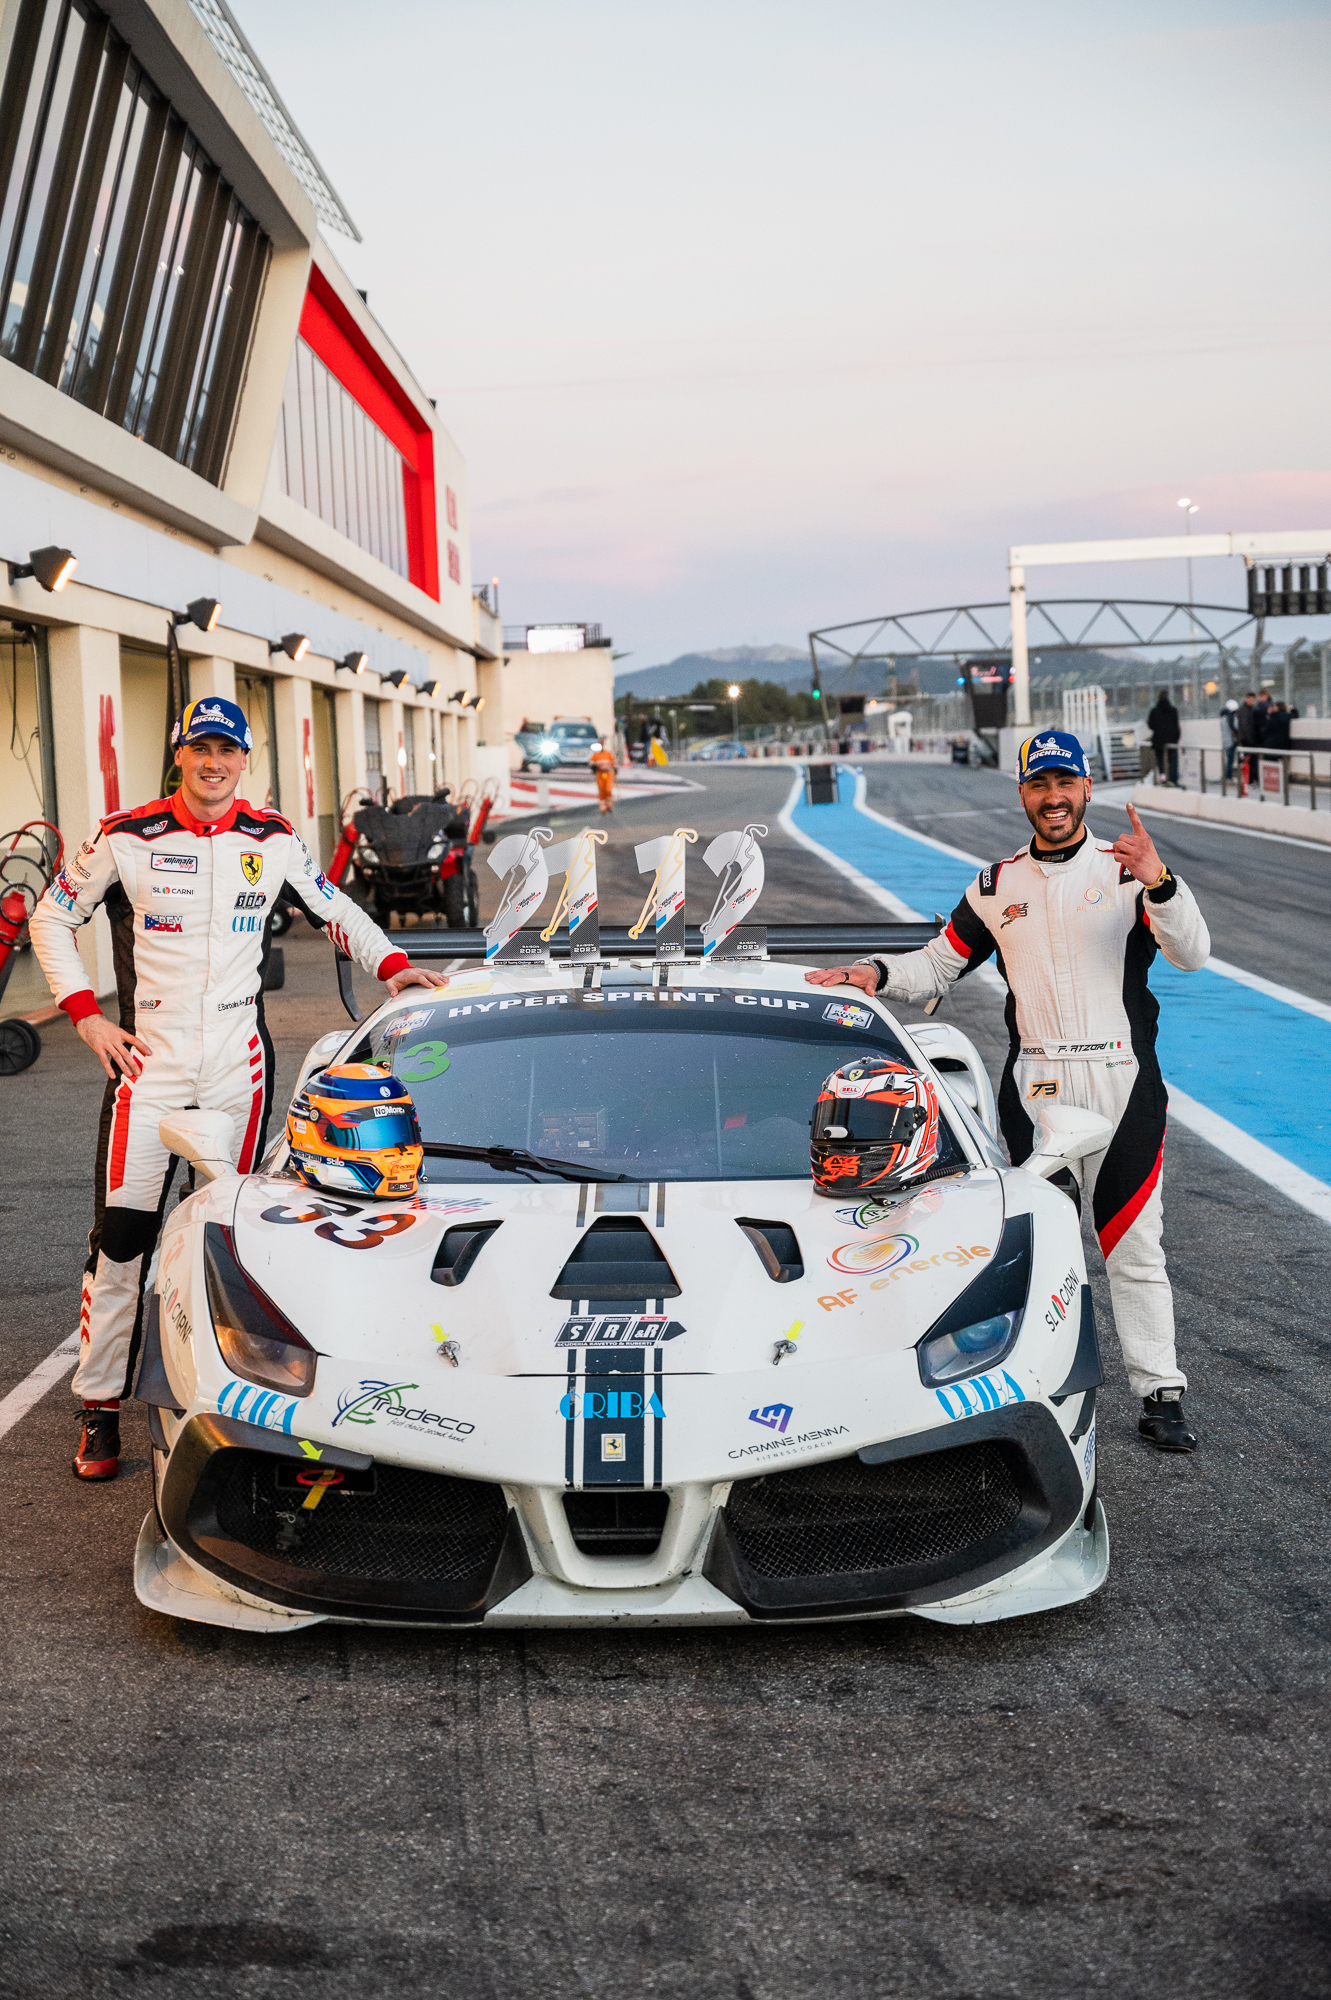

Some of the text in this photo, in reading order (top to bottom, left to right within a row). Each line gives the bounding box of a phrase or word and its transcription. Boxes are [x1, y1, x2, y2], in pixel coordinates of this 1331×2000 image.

[191, 716, 235, 729] MICHELIN
[1029, 750, 1072, 763] MICHELIN
[171, 888, 194, 896] CARNI
[449, 992, 810, 1018] HYPER SPRINT CUP
[832, 1012, 864, 1023] AUTO
[1057, 1045, 1068, 1054] F.
[1029, 1081, 1058, 1098] 73
[326, 1156, 345, 1167] Stilo
[260, 1196, 417, 1250] 33
[817, 1245, 991, 1312] AF energie
[1045, 1267, 1080, 1332] SL CARNI
[171, 1302, 193, 1345] CARNI
[570, 1324, 660, 1340] S R &R
[560, 1390, 667, 1420] CRIBA
[935, 1369, 1026, 1420] CRIBA
[217, 1381, 300, 1435] CRIBA
[372, 1395, 476, 1434] Tradeco
[387, 1417, 469, 1443] first choice second hand
[728, 1425, 850, 1459] CARMINE MENNA
[756, 1441, 833, 1462] FITNESS COACH
